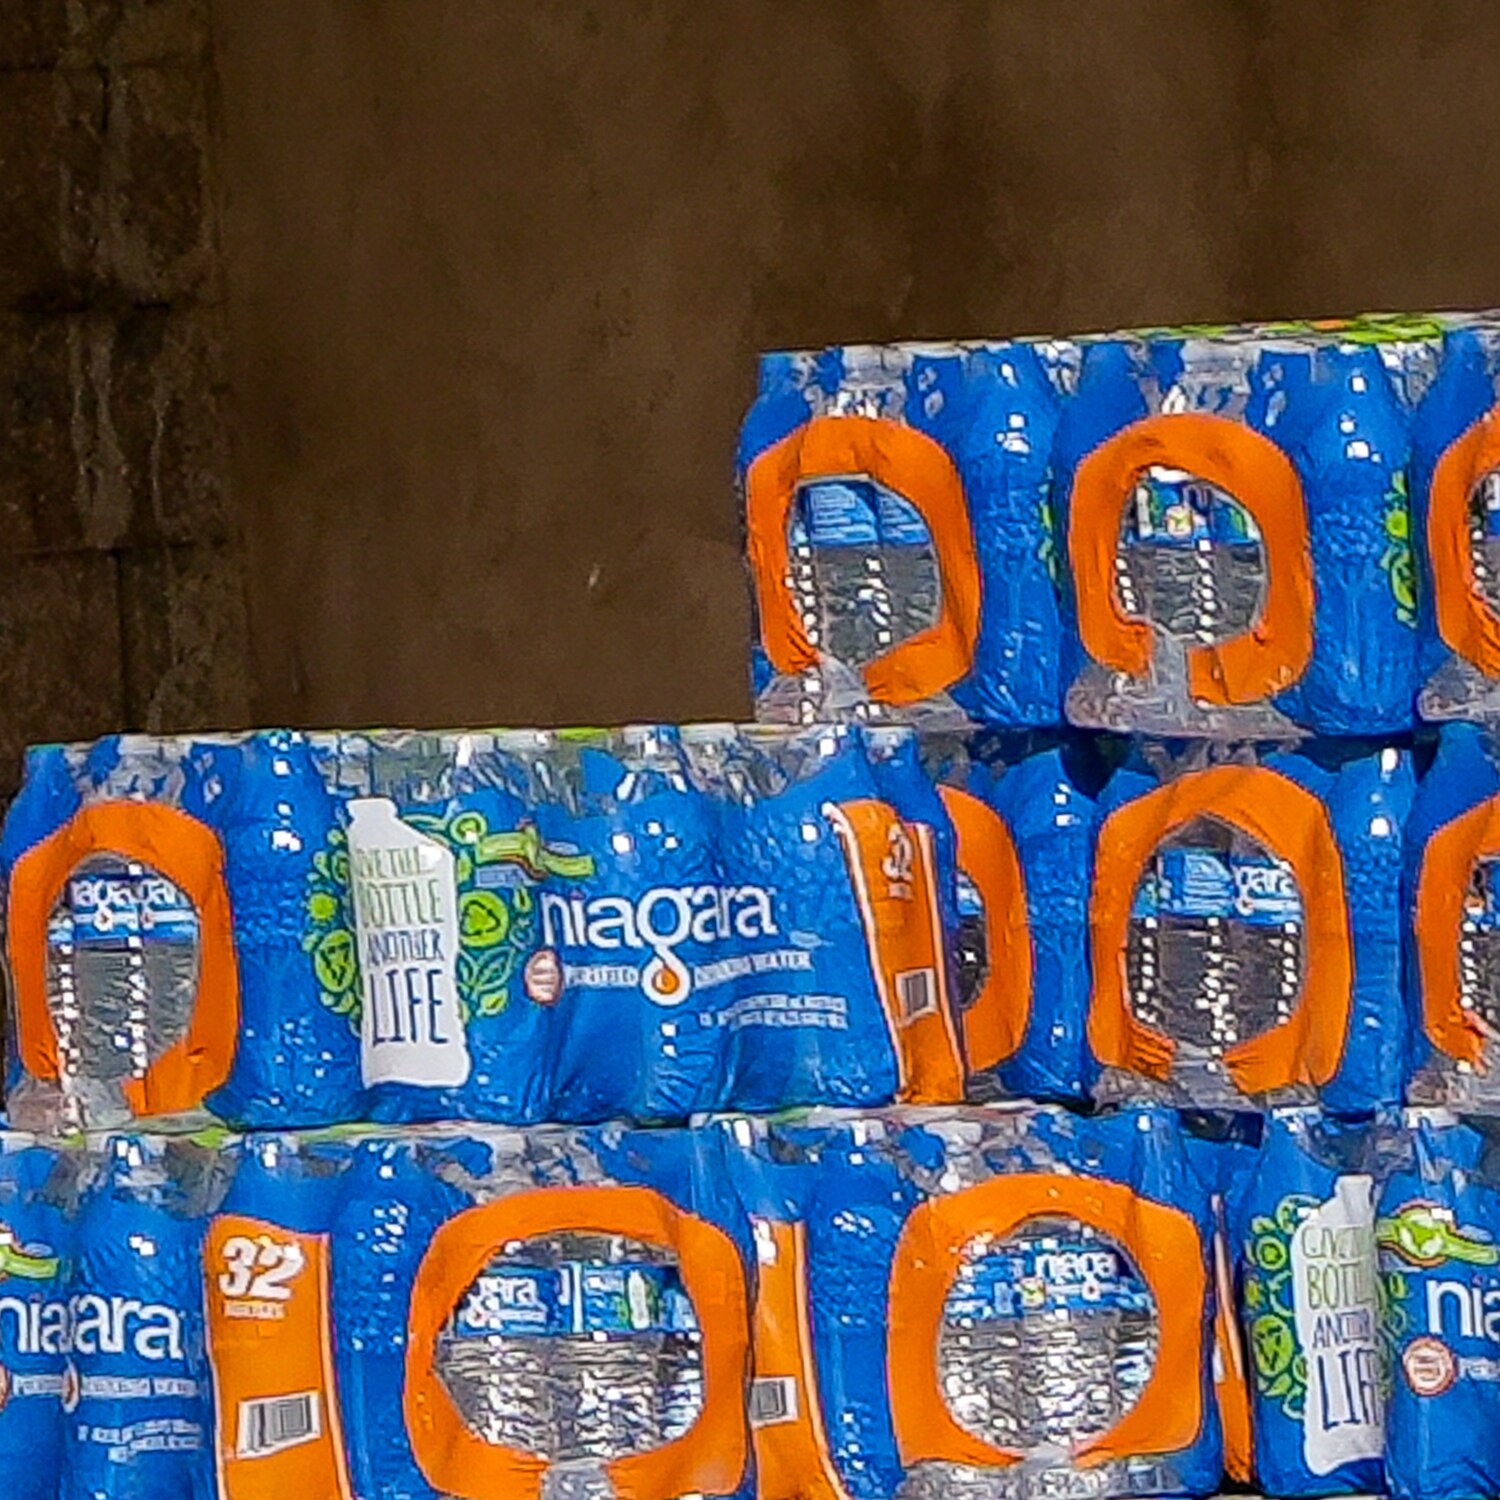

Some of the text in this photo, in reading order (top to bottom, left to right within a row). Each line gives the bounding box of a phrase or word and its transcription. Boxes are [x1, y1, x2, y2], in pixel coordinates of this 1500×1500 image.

[539, 884, 778, 982] niagara
[370, 967, 449, 1046] LIFE
[220, 1236, 305, 1299] 32
[0, 1293, 184, 1388] niaara
